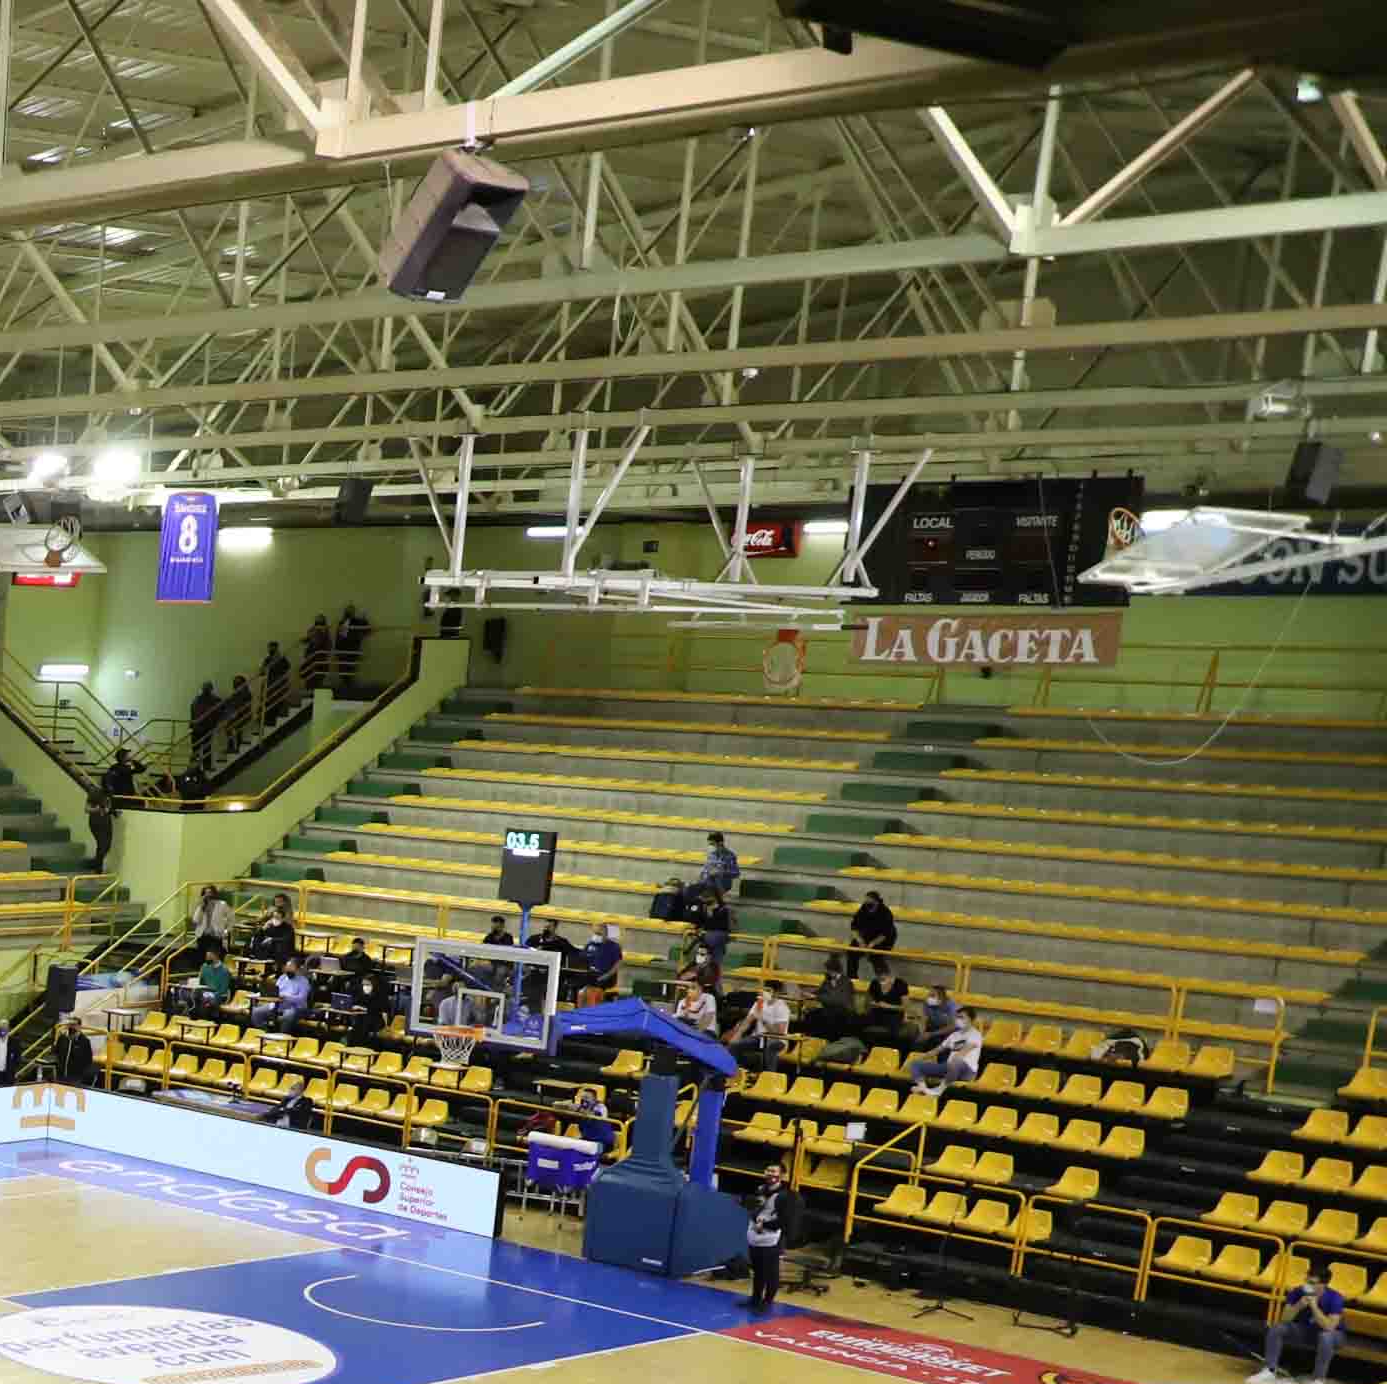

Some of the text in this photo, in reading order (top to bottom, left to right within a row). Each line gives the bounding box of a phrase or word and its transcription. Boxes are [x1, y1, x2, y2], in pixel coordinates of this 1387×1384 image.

[178, 514, 198, 554] 8
[913, 516, 955, 529] LOCAL
[860, 616, 1100, 664] LA GACETA
[59, 1158, 411, 1241] endesa
[754, 1330, 908, 1372] VALENCIA
